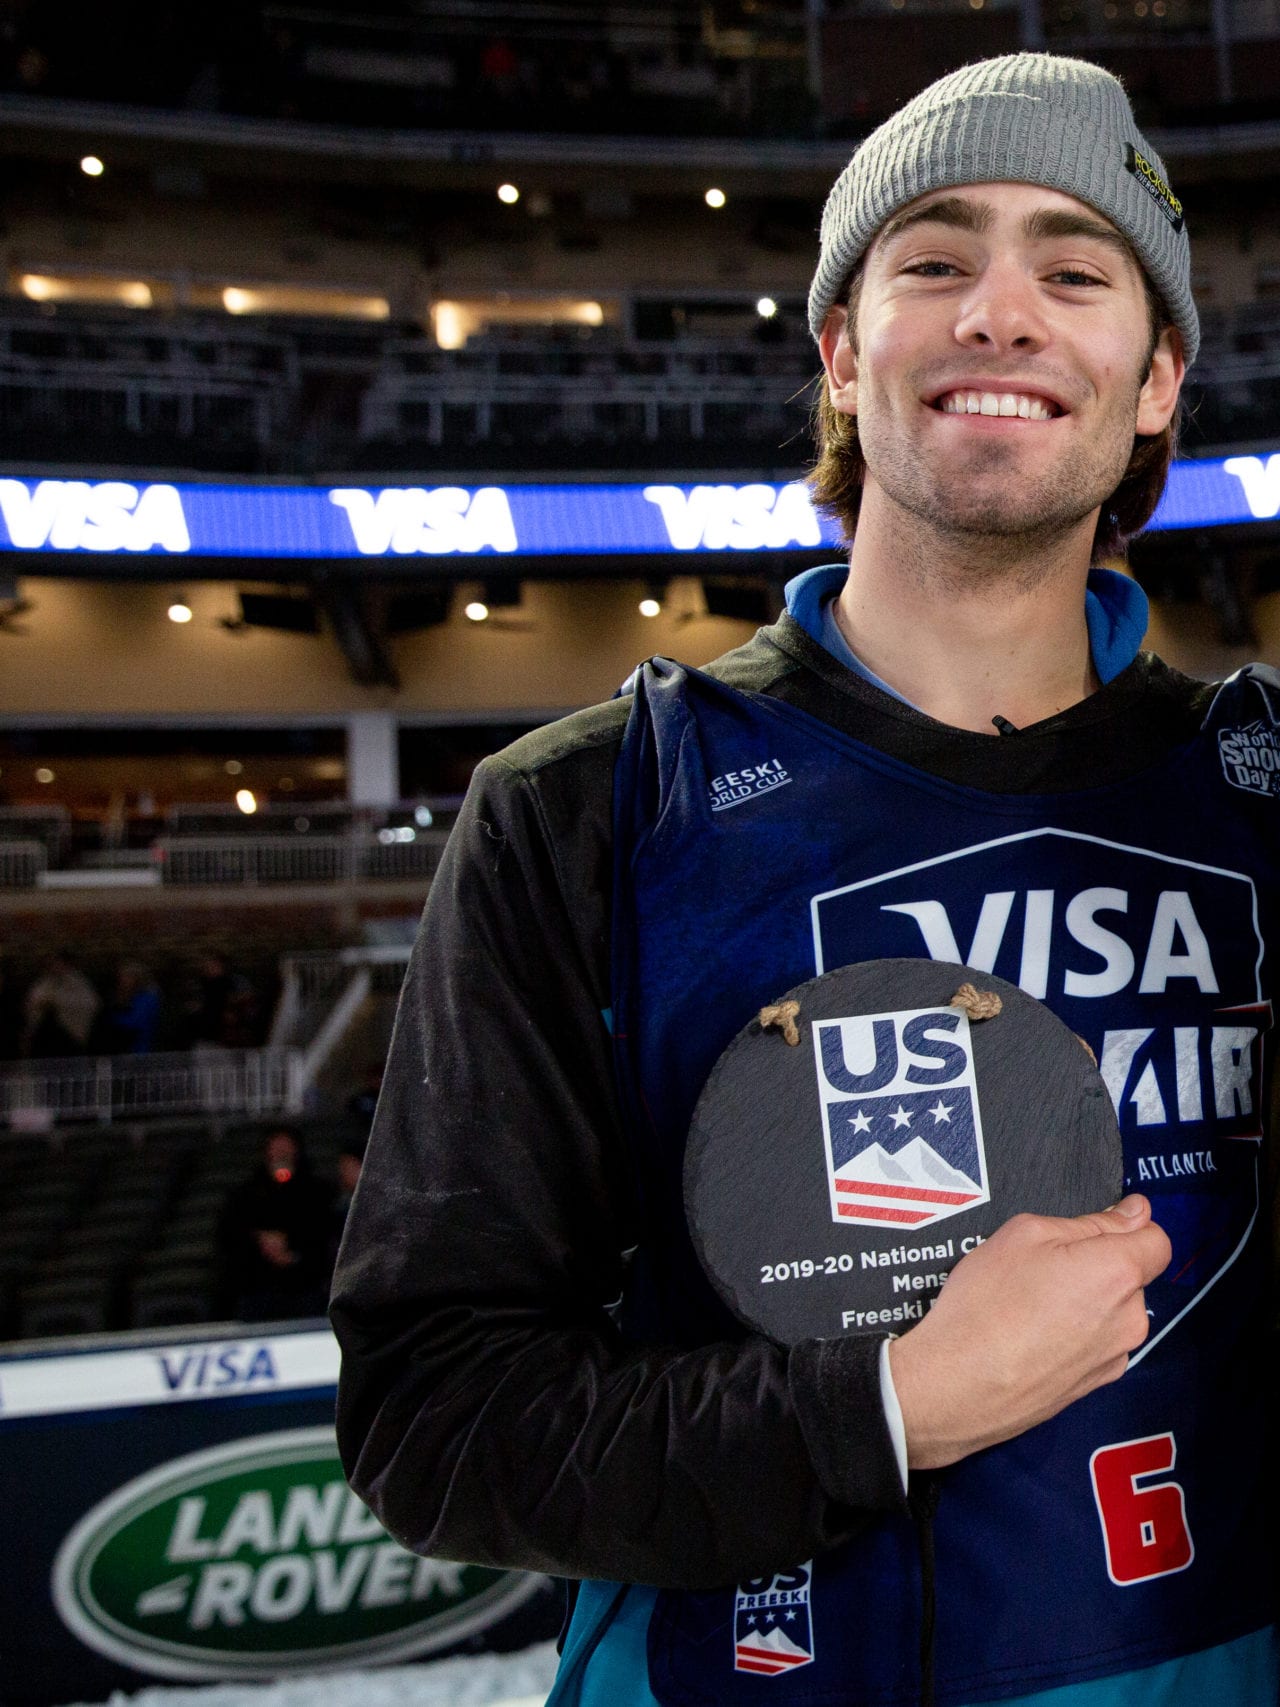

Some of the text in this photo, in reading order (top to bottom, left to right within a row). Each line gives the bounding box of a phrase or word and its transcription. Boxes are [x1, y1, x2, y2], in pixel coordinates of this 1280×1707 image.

[0, 478, 191, 552] VISA
[329, 486, 518, 554] VISA
[642, 483, 822, 550] VISA
[710, 770, 788, 808] ORLD CUP
[711, 758, 782, 793] EESKI
[1234, 765, 1270, 791] Day
[880, 886, 1221, 1000] VISA
[818, 1013, 969, 1094] US
[1137, 1150, 1219, 1182] ATLANTA
[760, 1254, 853, 1284] 2019-20
[860, 1239, 955, 1270] National
[892, 1272, 949, 1293] Mens
[841, 1300, 923, 1329] Freeski
[157, 1342, 278, 1391] VISA
[166, 1482, 392, 1563] LAND
[1090, 1431, 1195, 1586] 6
[192, 1543, 466, 1630] ROVER
[737, 1590, 809, 1609] FREESKI
